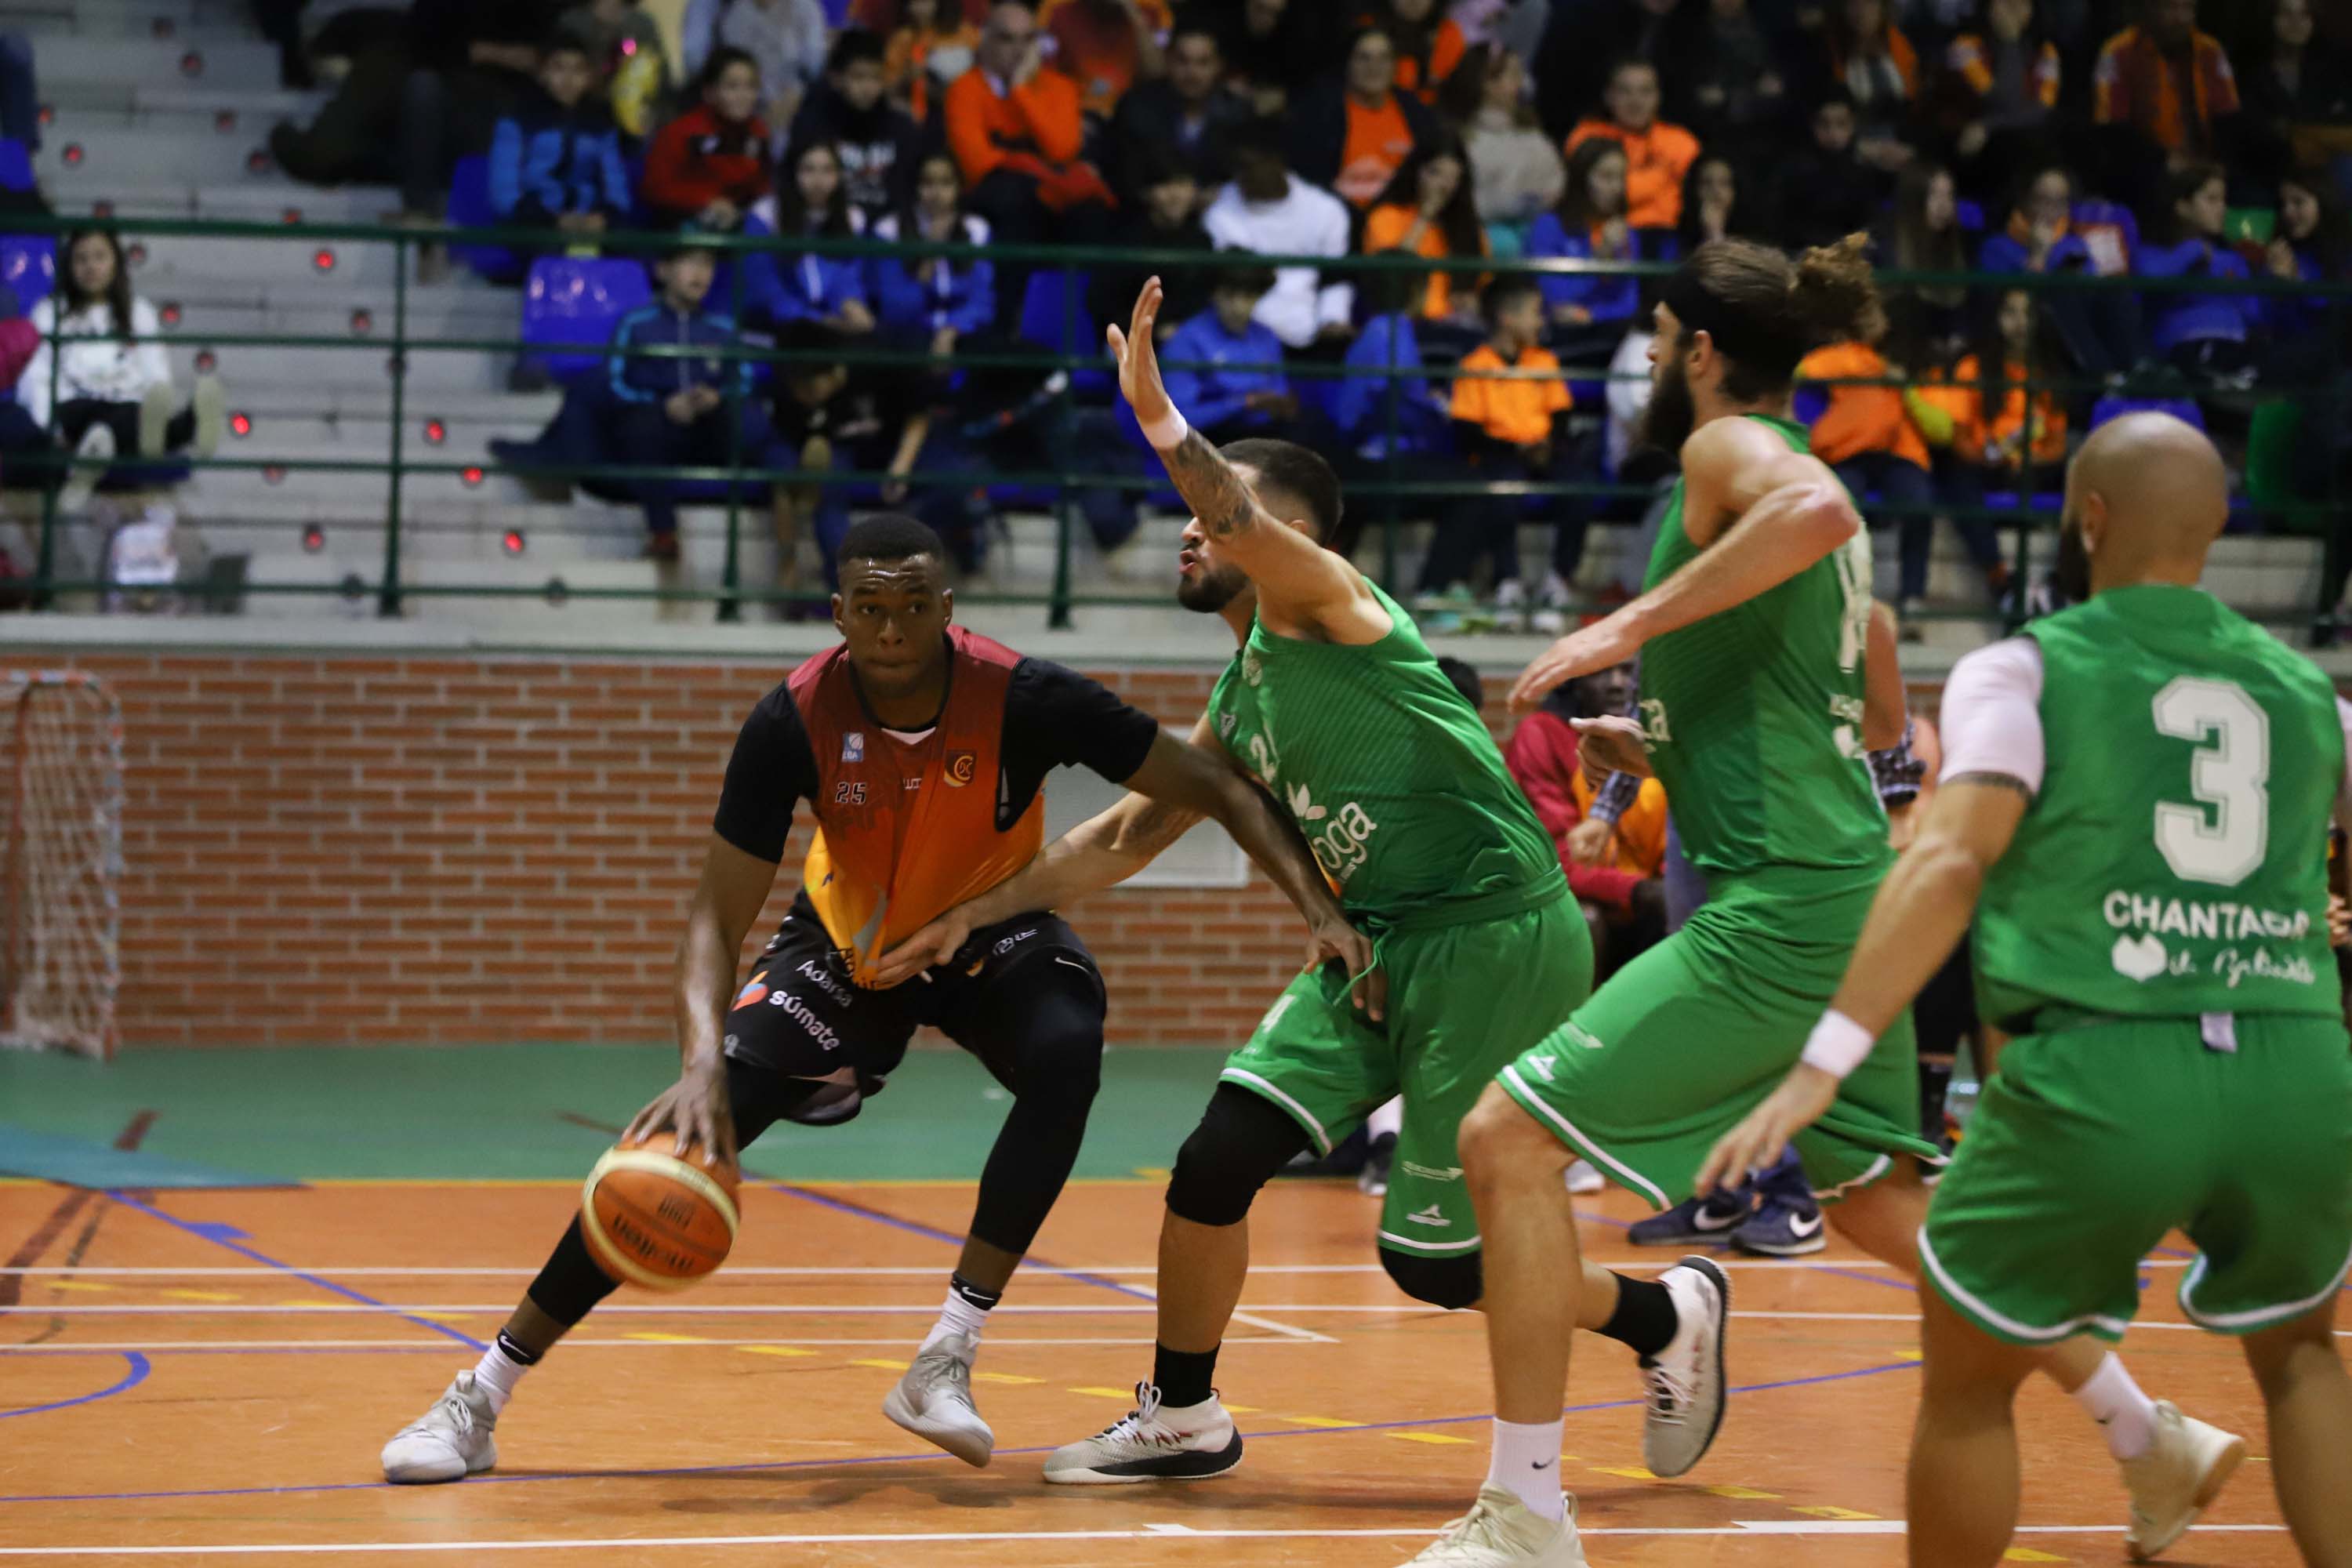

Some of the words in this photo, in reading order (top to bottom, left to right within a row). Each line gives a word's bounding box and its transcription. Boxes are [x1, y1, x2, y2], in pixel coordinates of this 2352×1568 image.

[836, 782, 866, 805] 25
[2152, 675, 2270, 887] 3
[1311, 801, 1377, 869] oga
[796, 960, 853, 1007] Adarsa
[768, 990, 840, 1051] súmate
